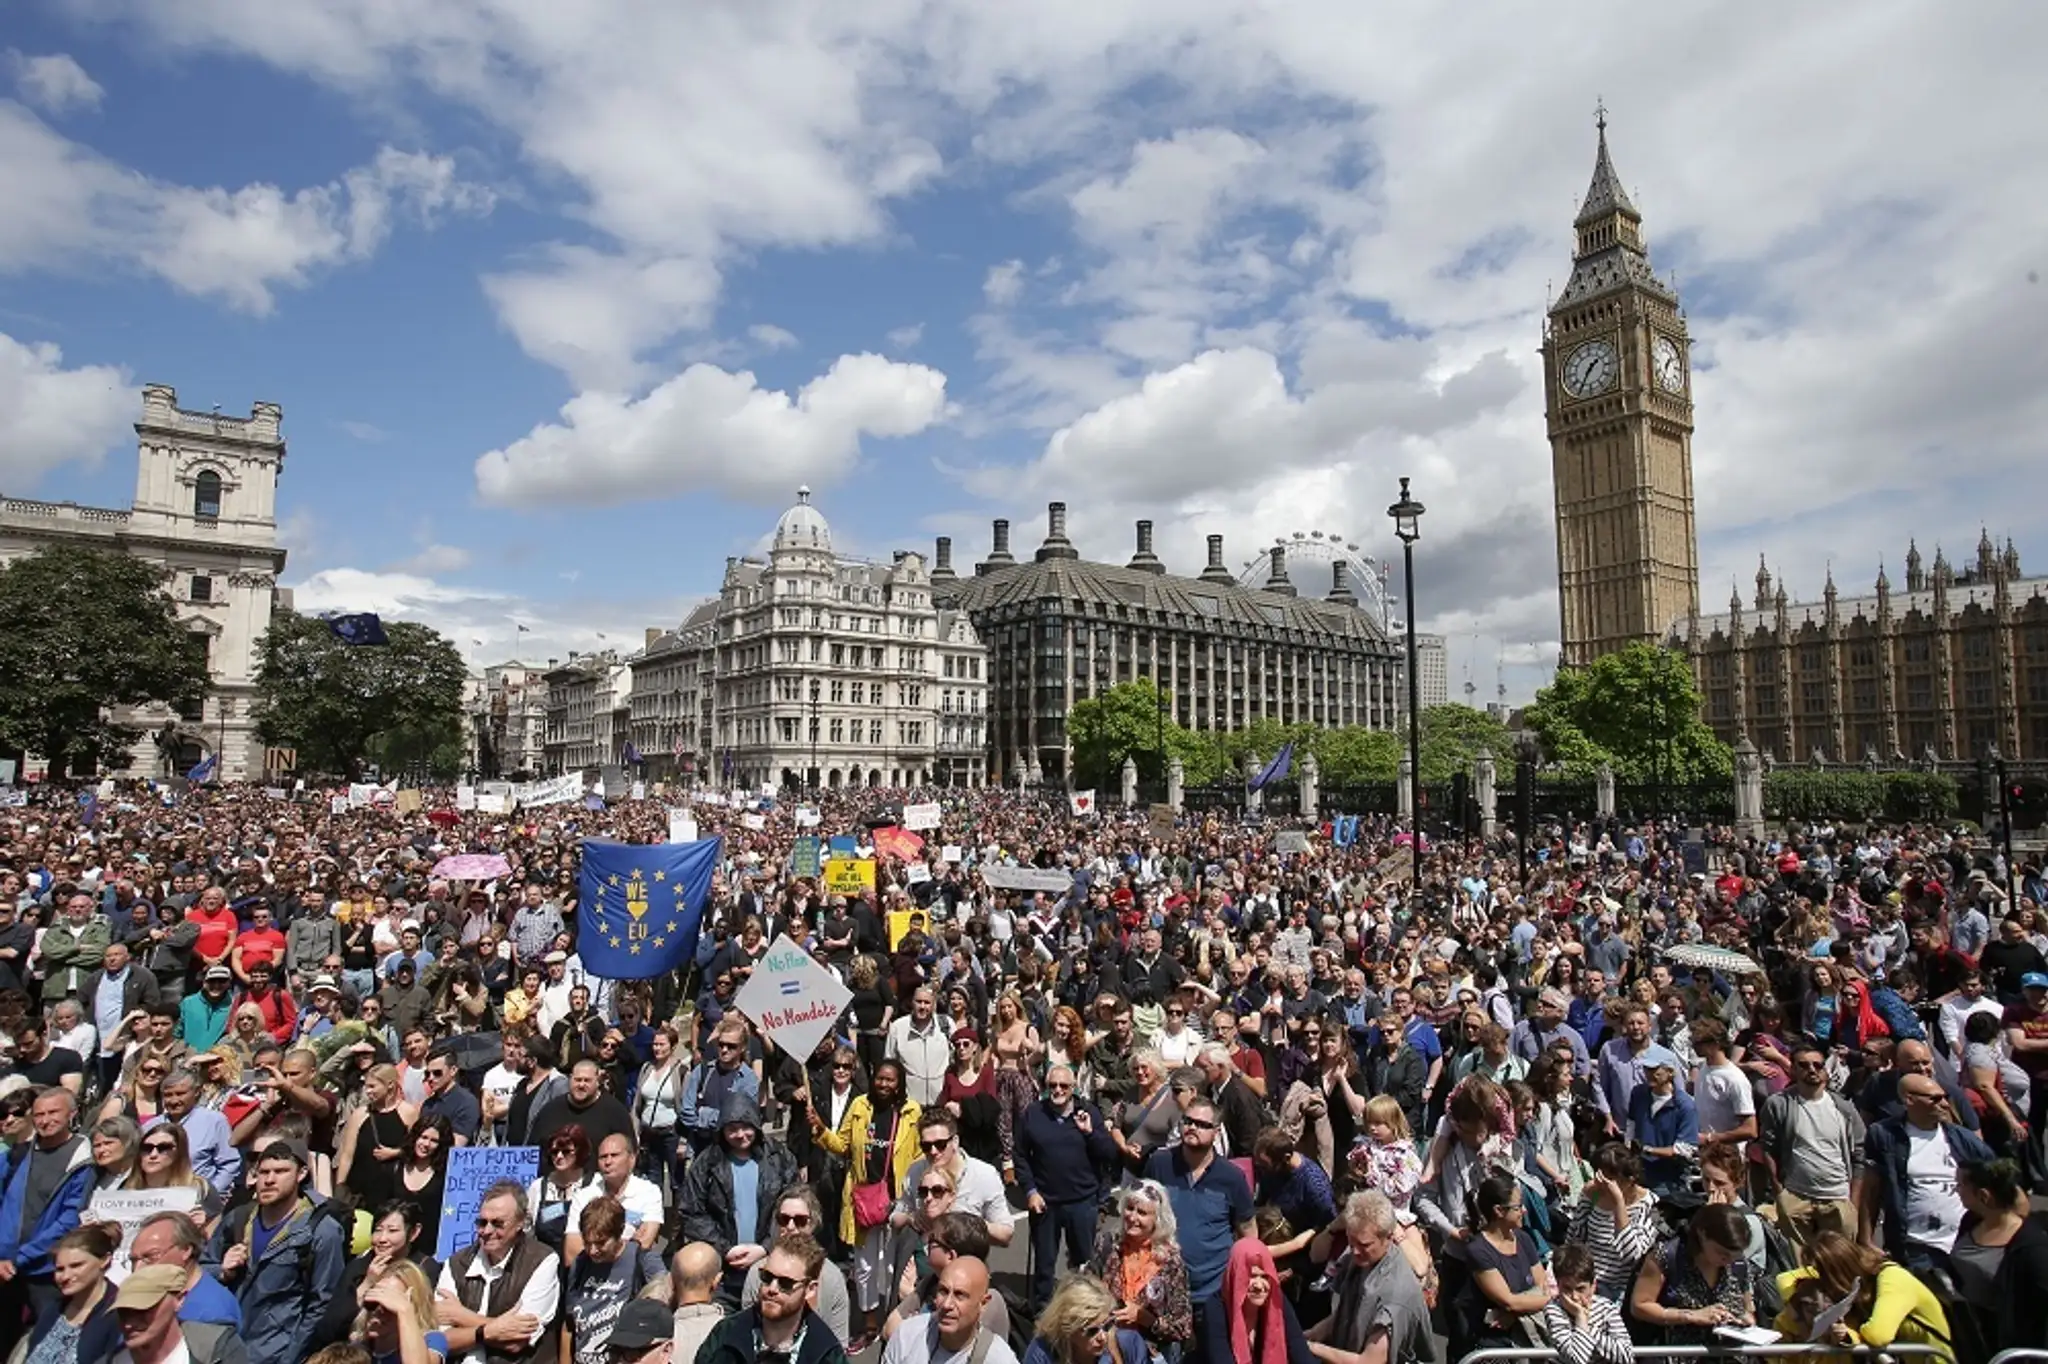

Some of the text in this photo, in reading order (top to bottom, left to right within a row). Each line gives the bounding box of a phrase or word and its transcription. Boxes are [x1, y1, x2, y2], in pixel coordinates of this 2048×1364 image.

[270, 750, 293, 769] IN
[625, 882, 649, 900] WE
[628, 922, 649, 940] EU
[767, 951, 809, 972] No Plan
[762, 999, 838, 1031] No Mandate
[453, 1149, 540, 1166] MY FUTURE
[505, 1165, 519, 1175] BE
[100, 1199, 124, 1209] LOVE
